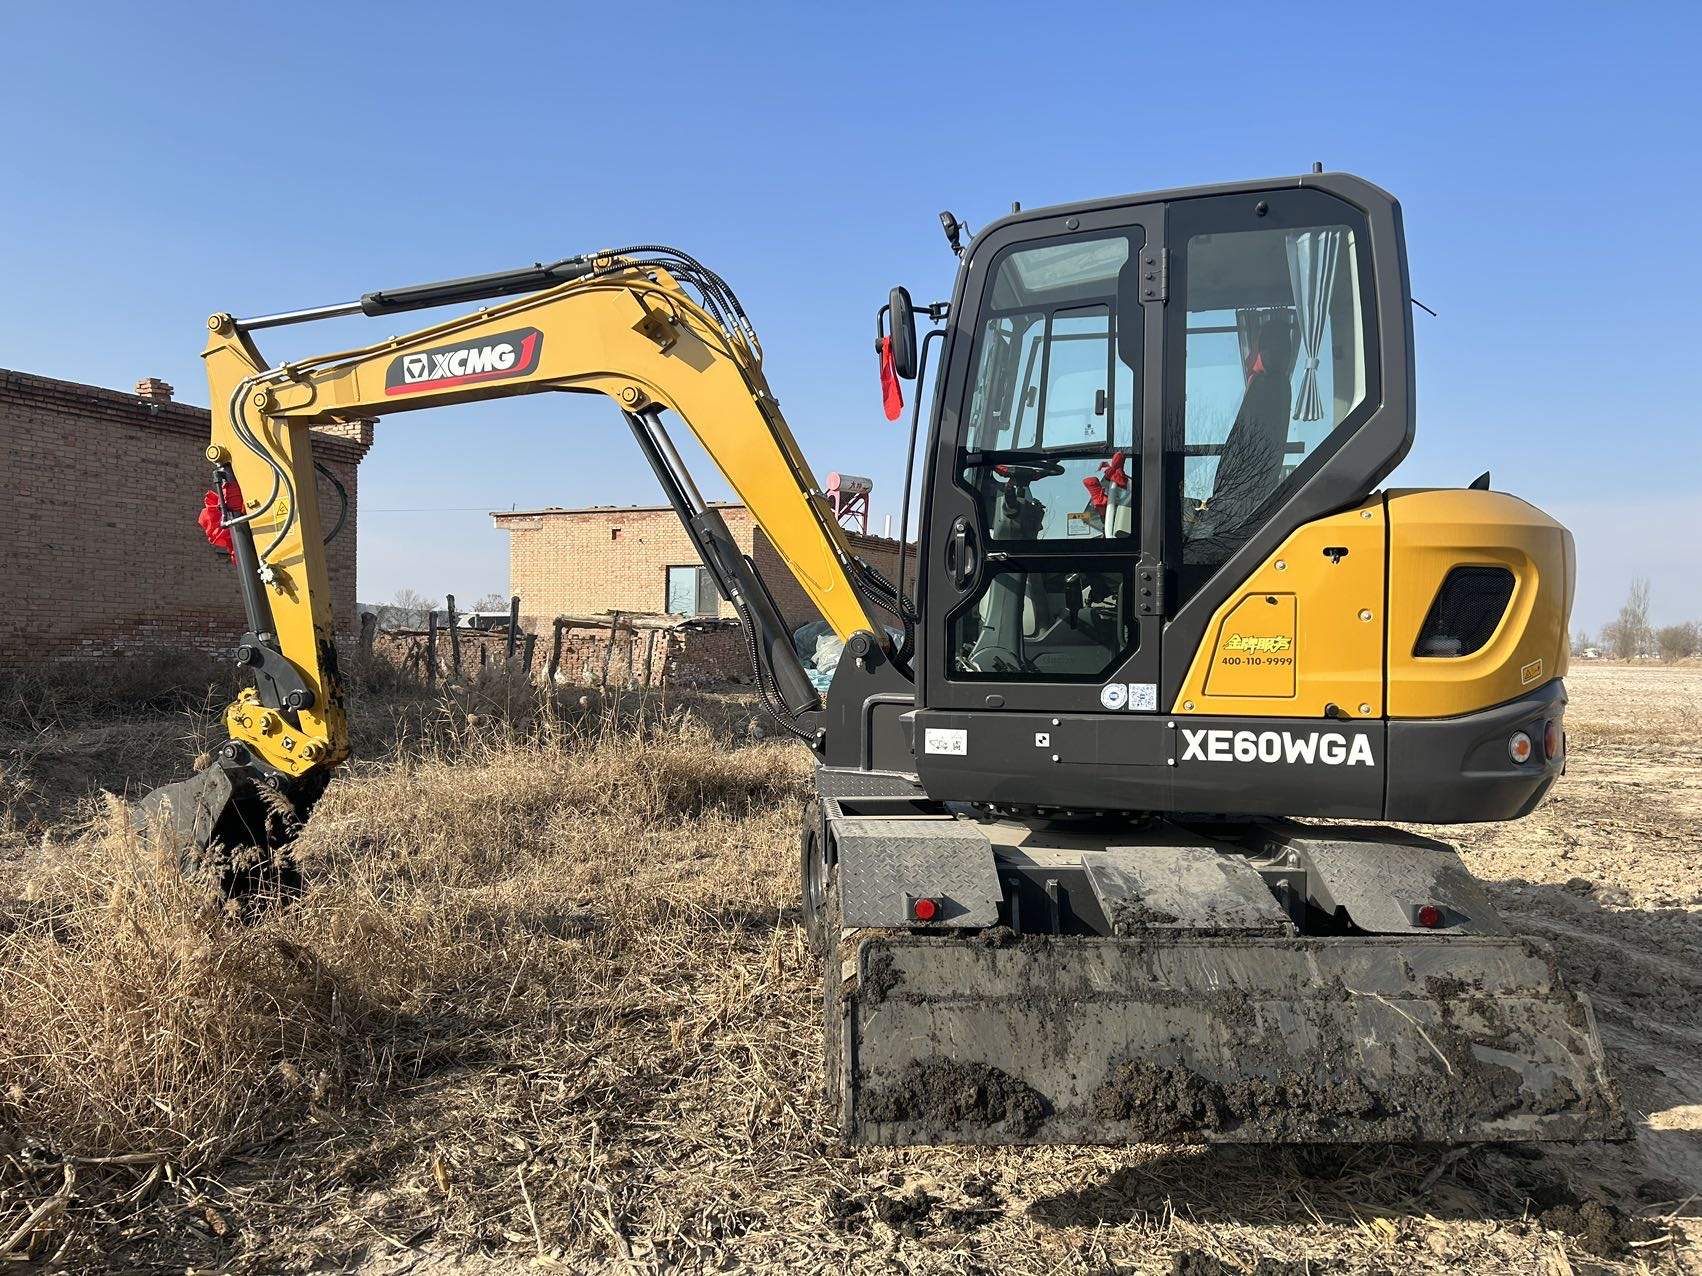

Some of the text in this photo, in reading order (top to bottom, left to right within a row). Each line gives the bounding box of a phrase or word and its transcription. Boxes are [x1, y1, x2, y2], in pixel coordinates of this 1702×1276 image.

[428, 343, 515, 380] XCMG
[1222, 657, 1293, 666] 400-110-9999
[1181, 729, 1375, 766] XE60WGA
